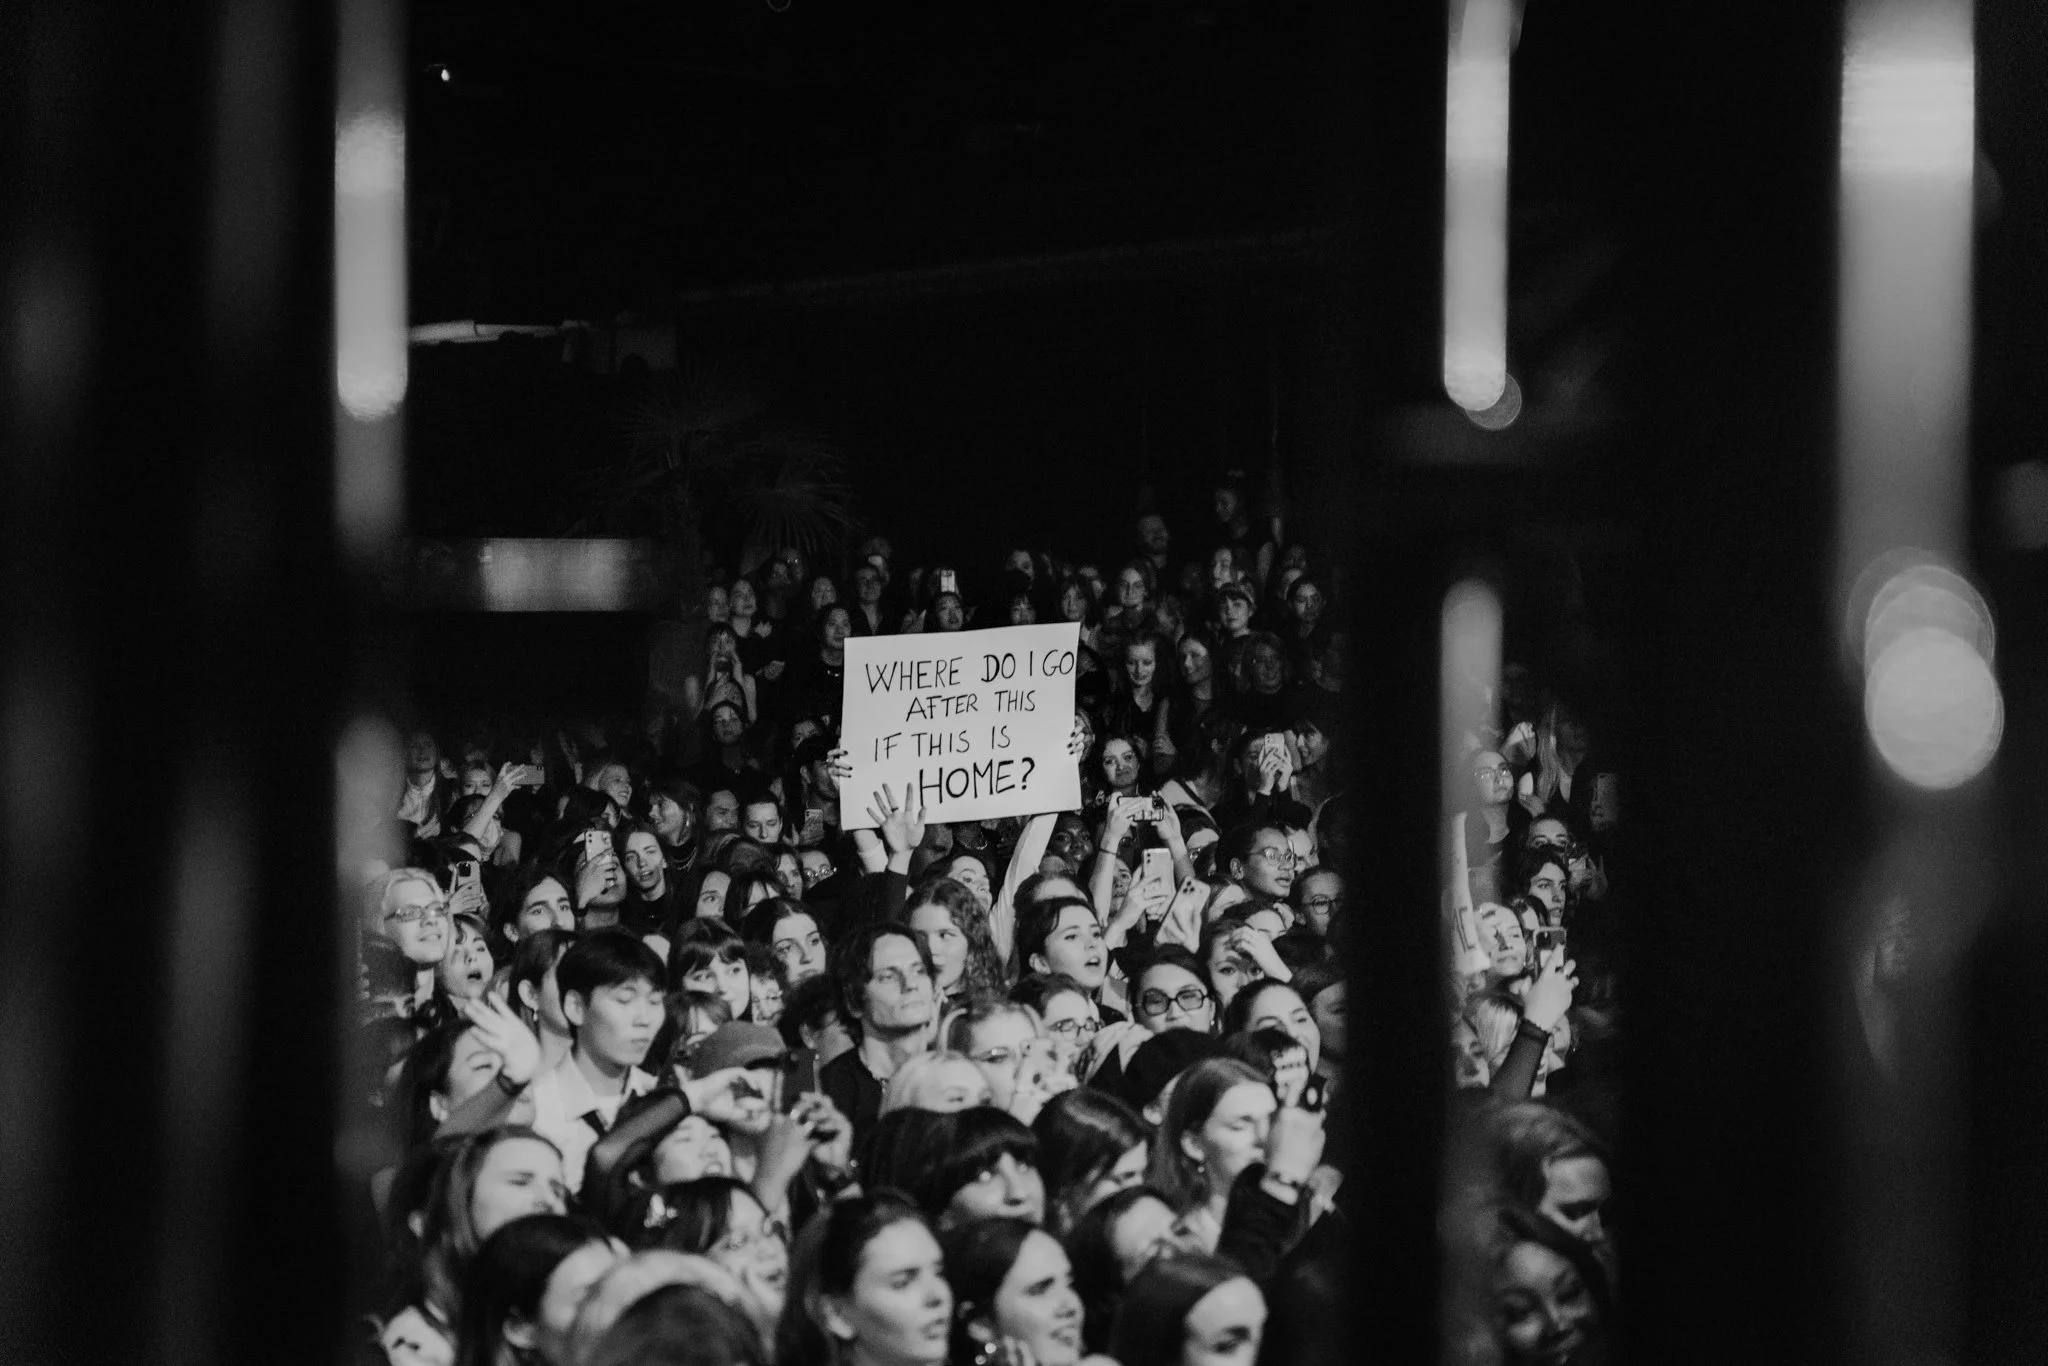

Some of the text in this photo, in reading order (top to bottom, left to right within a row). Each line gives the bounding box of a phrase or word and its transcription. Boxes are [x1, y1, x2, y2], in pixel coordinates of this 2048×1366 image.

[865, 649, 1075, 694] WHERE DO I GO
[905, 689, 1036, 722] AFTER THIS
[874, 725, 1011, 762] IF THIS IS
[919, 756, 1035, 807] HOME?
